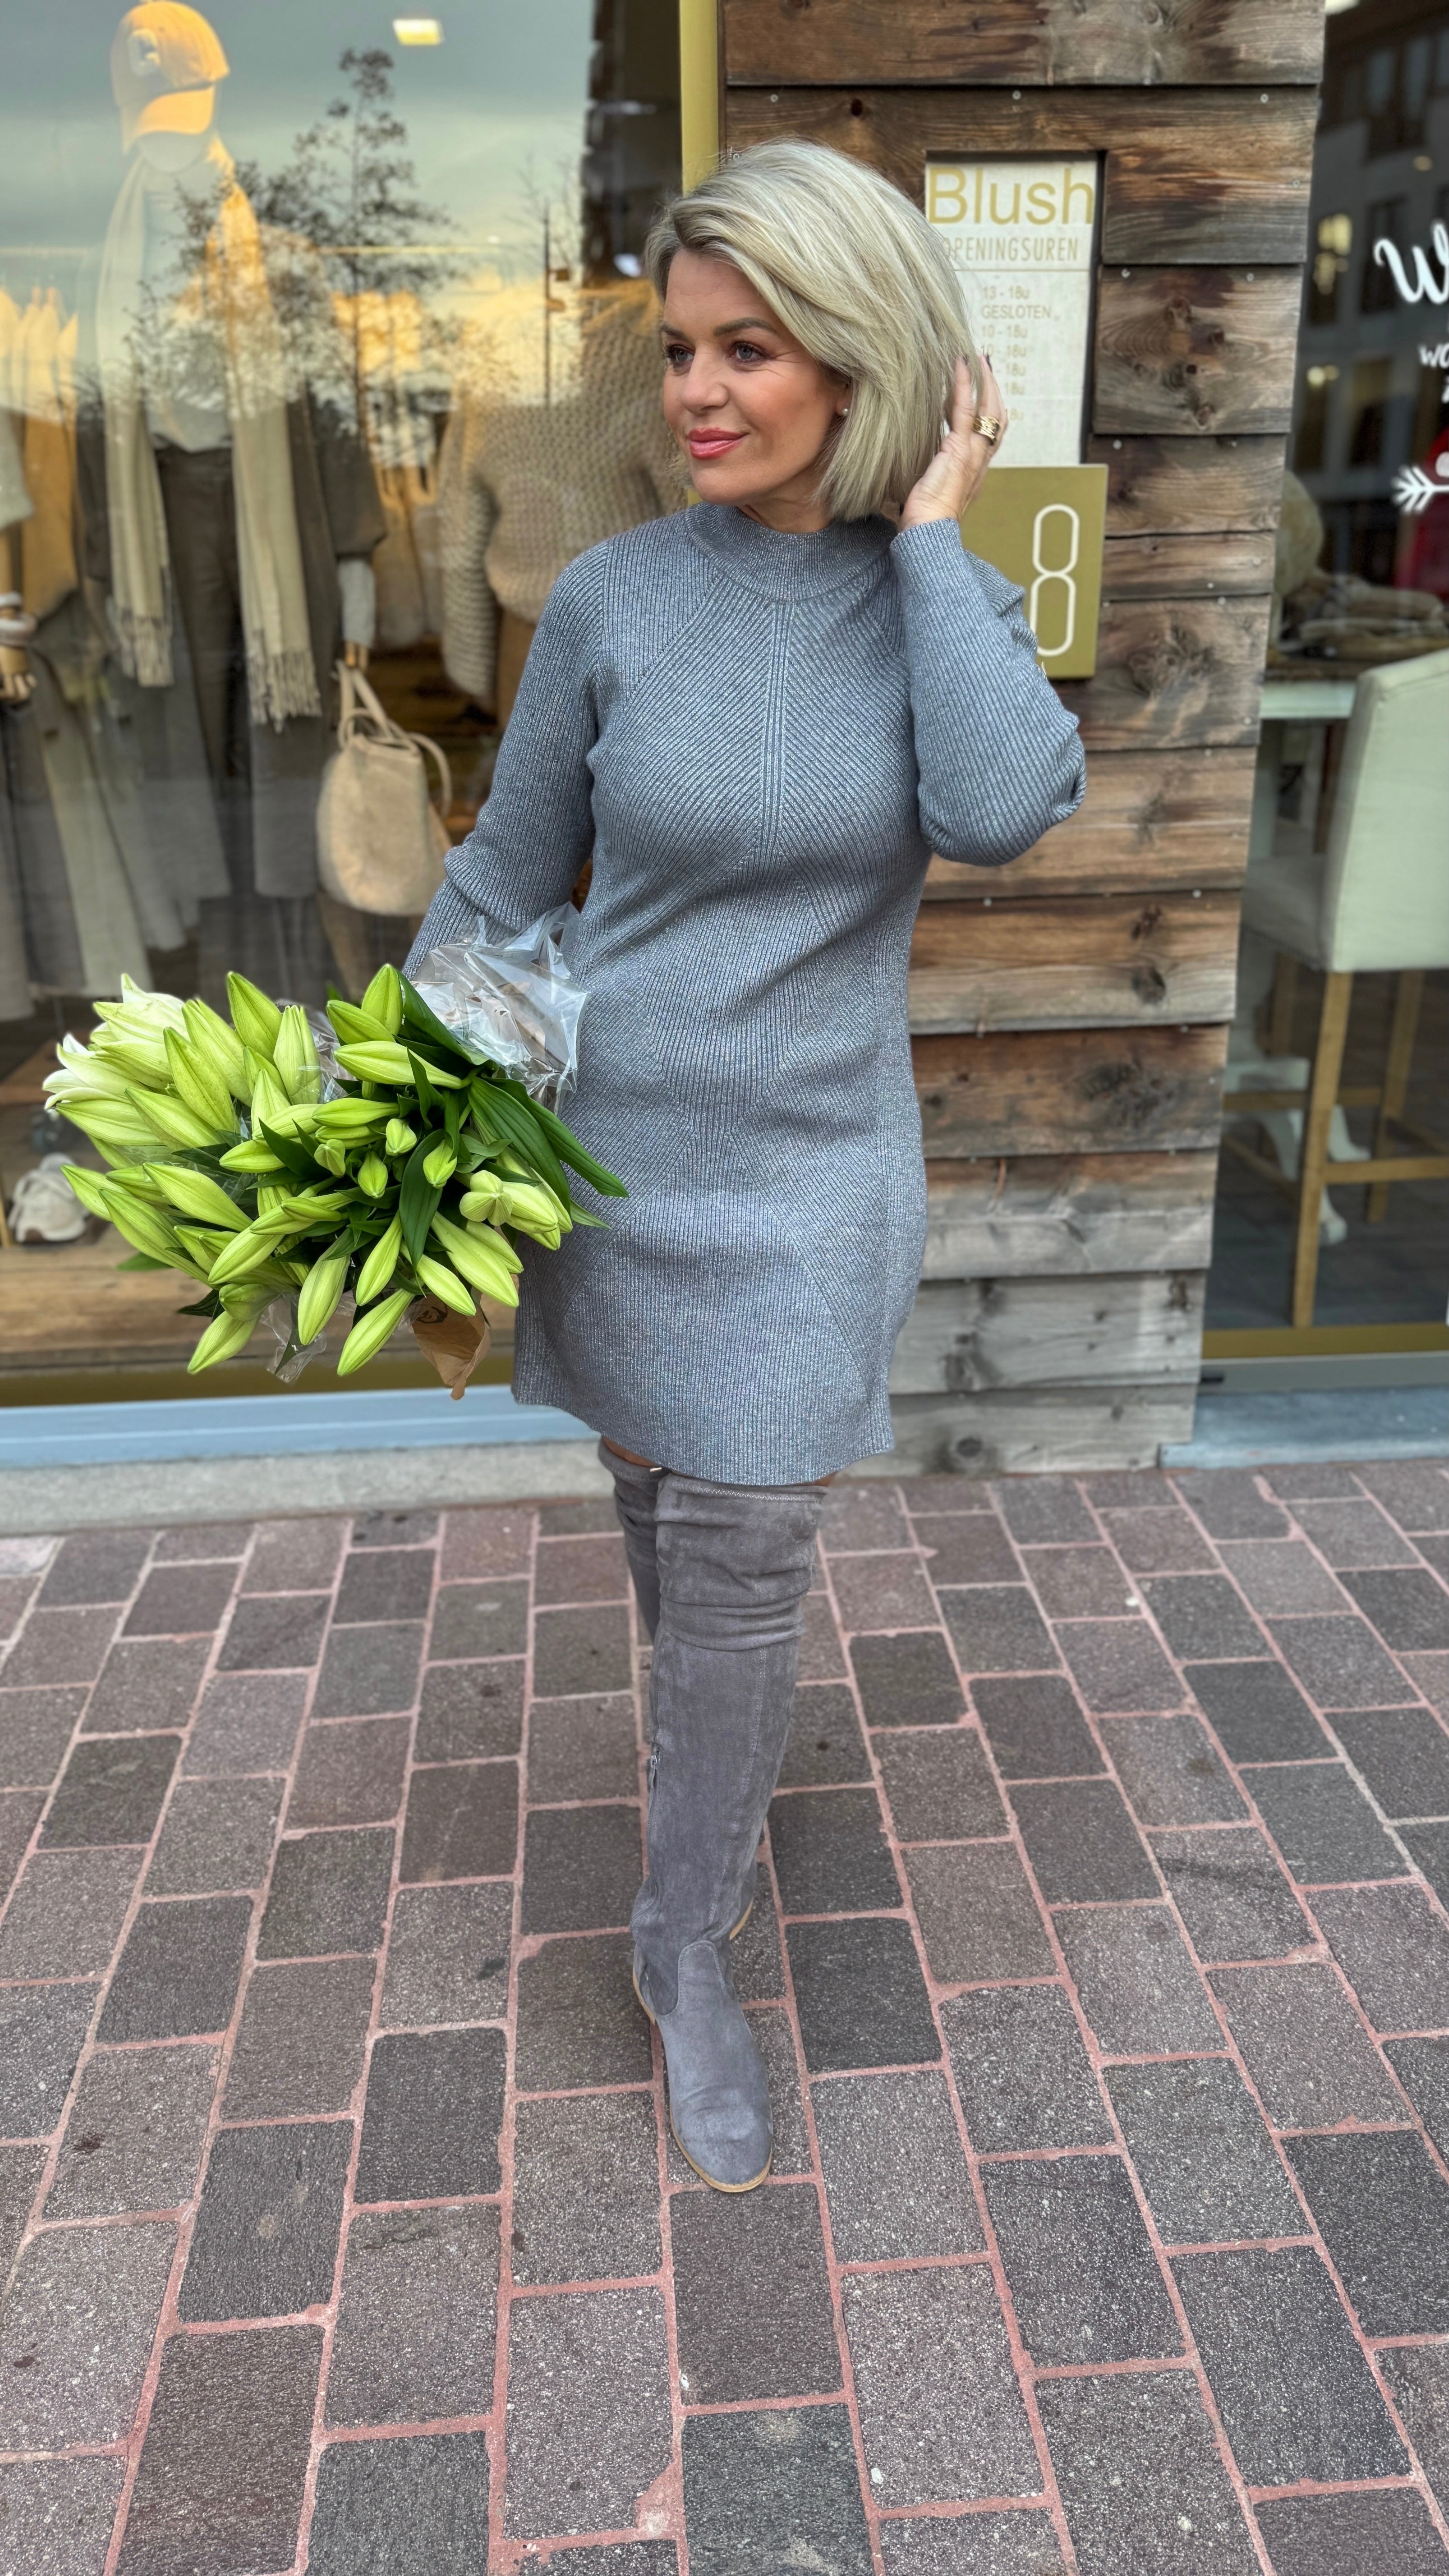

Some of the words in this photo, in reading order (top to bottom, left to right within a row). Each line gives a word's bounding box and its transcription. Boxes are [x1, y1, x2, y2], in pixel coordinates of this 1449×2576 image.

[929, 167, 1094, 225] Blush
[982, 286, 996, 299] 13
[1009, 286, 1030, 299] 18u
[981, 304, 1052, 319] GESLOTEN
[982, 324, 995, 337] 10
[1007, 324, 1028, 338] 18u
[1006, 344, 1026, 357] 18u
[1006, 363, 1026, 376] 18u
[1030, 503, 1080, 656] 8
